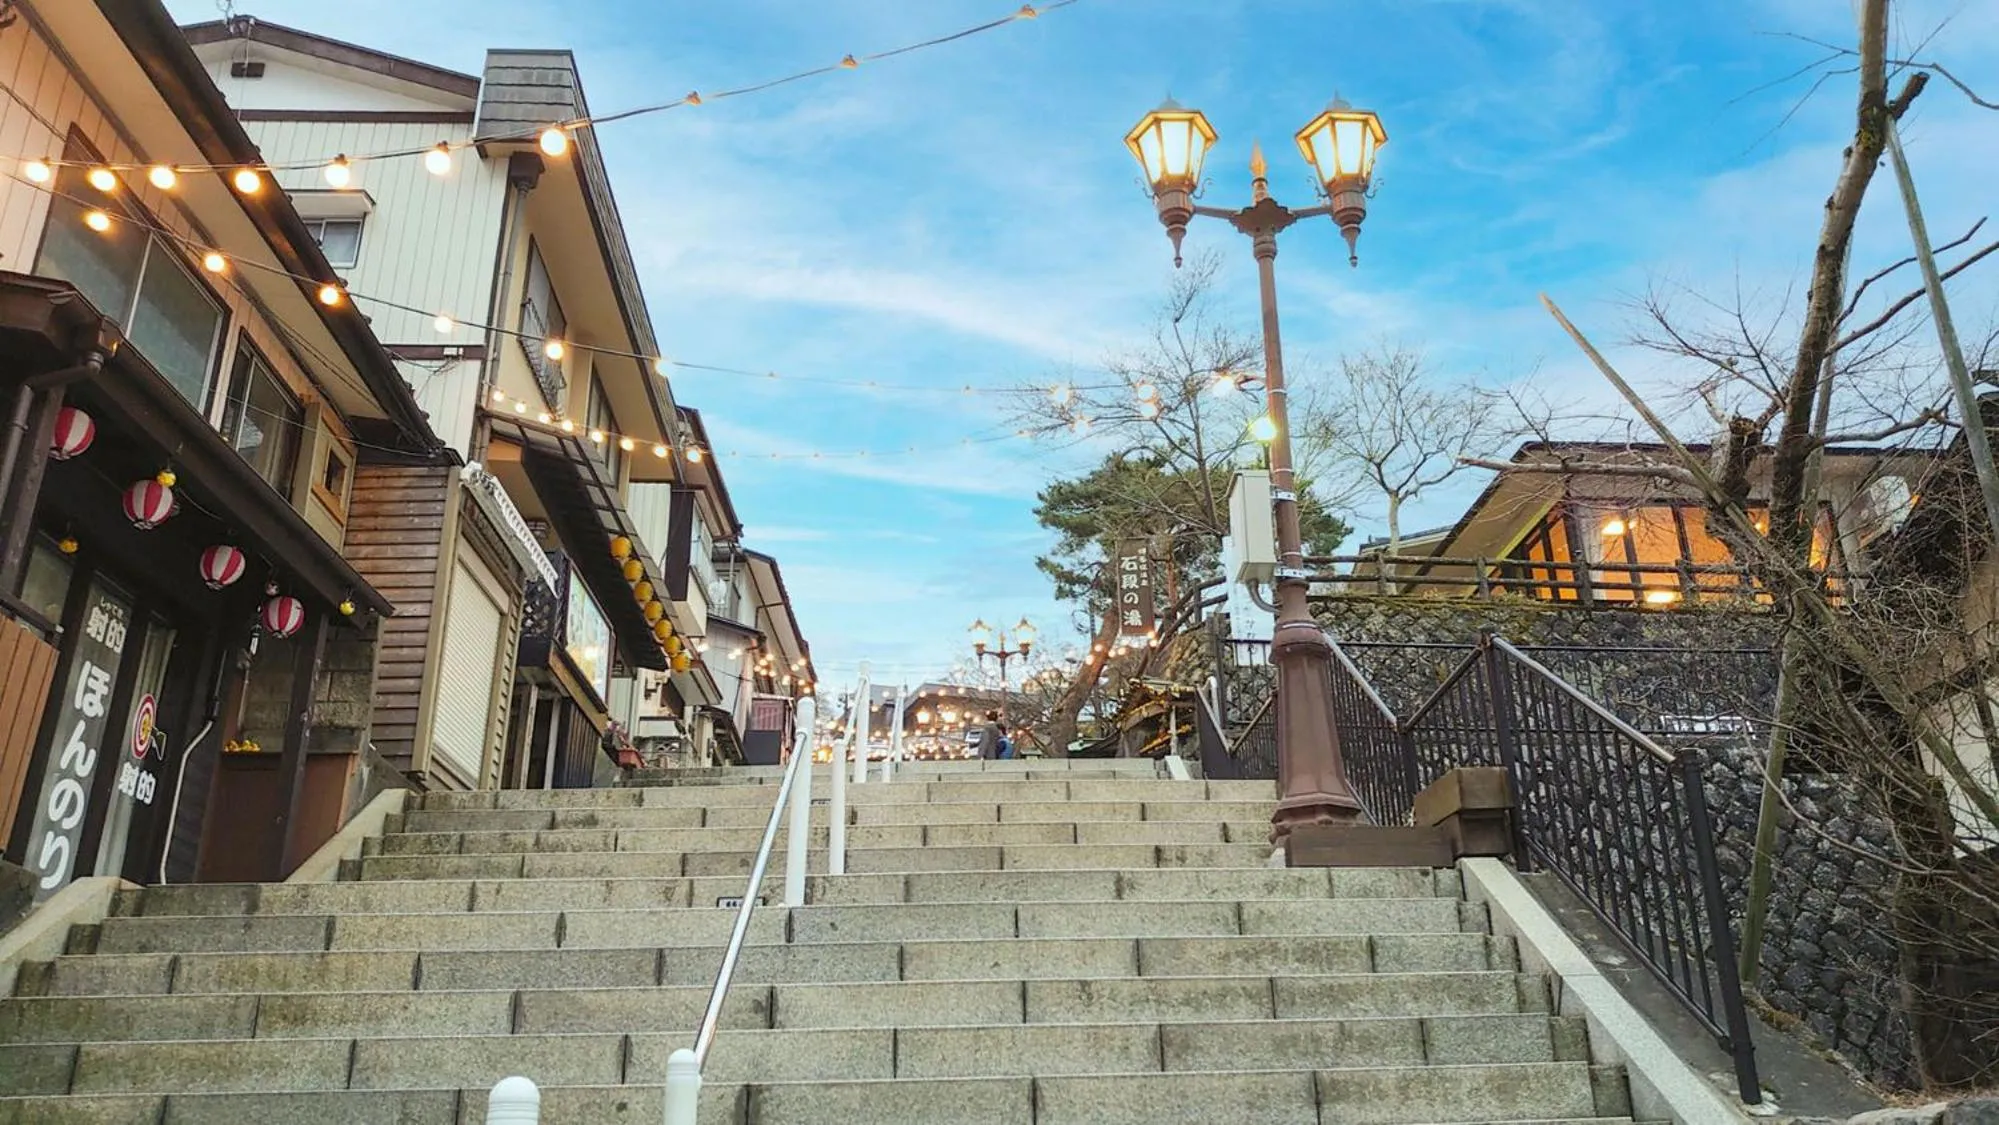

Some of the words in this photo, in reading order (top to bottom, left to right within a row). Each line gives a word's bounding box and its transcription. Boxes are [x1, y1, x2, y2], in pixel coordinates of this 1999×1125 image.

[1120, 556, 1142, 626] 石段の湯
[86, 606, 126, 653] 射的
[40, 660, 111, 890] ほんのり
[118, 761, 156, 805] 射的
